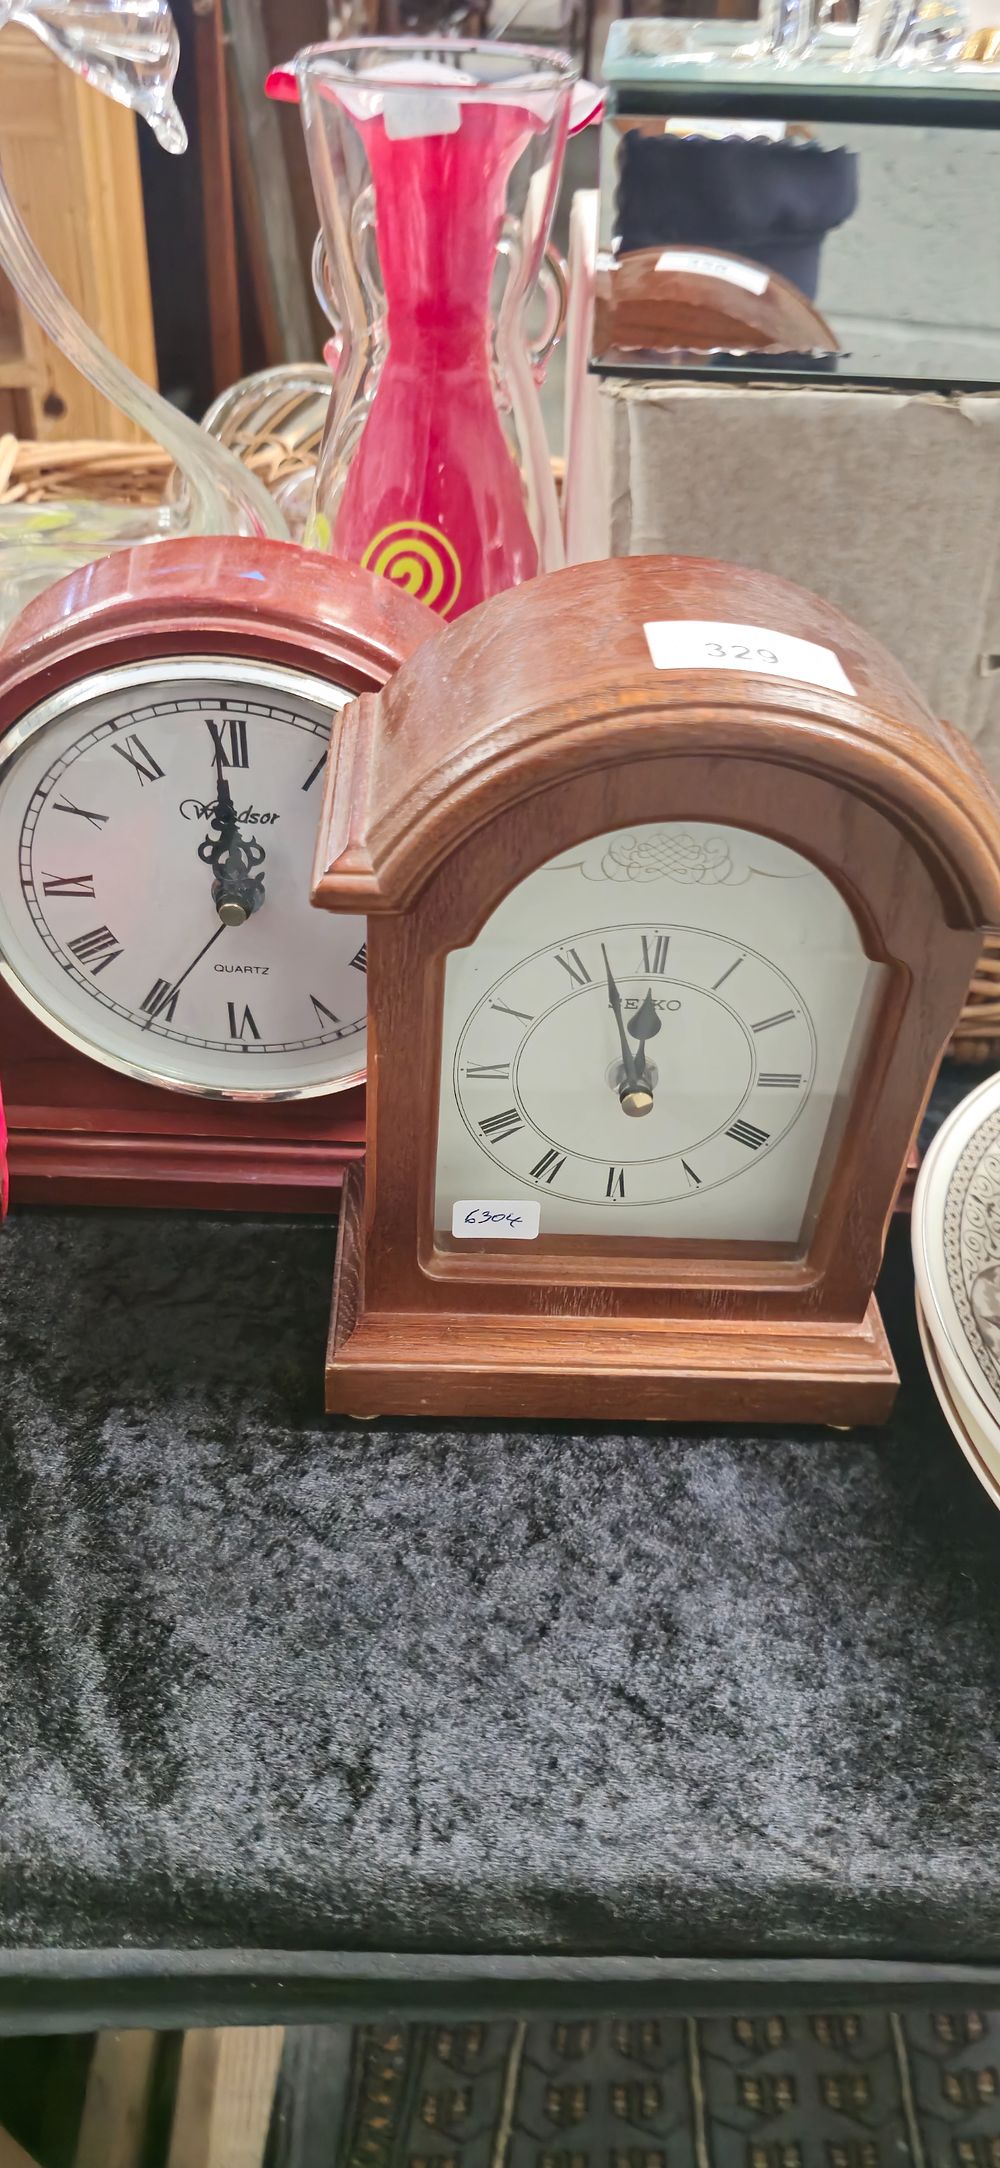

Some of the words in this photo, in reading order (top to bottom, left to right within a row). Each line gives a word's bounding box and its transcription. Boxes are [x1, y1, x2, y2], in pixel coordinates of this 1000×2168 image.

[704, 642, 779, 665] 329
[179, 799, 280, 824] Wdsor
[213, 963, 270, 976] QUARTZ
[608, 998, 682, 1012] EKO
